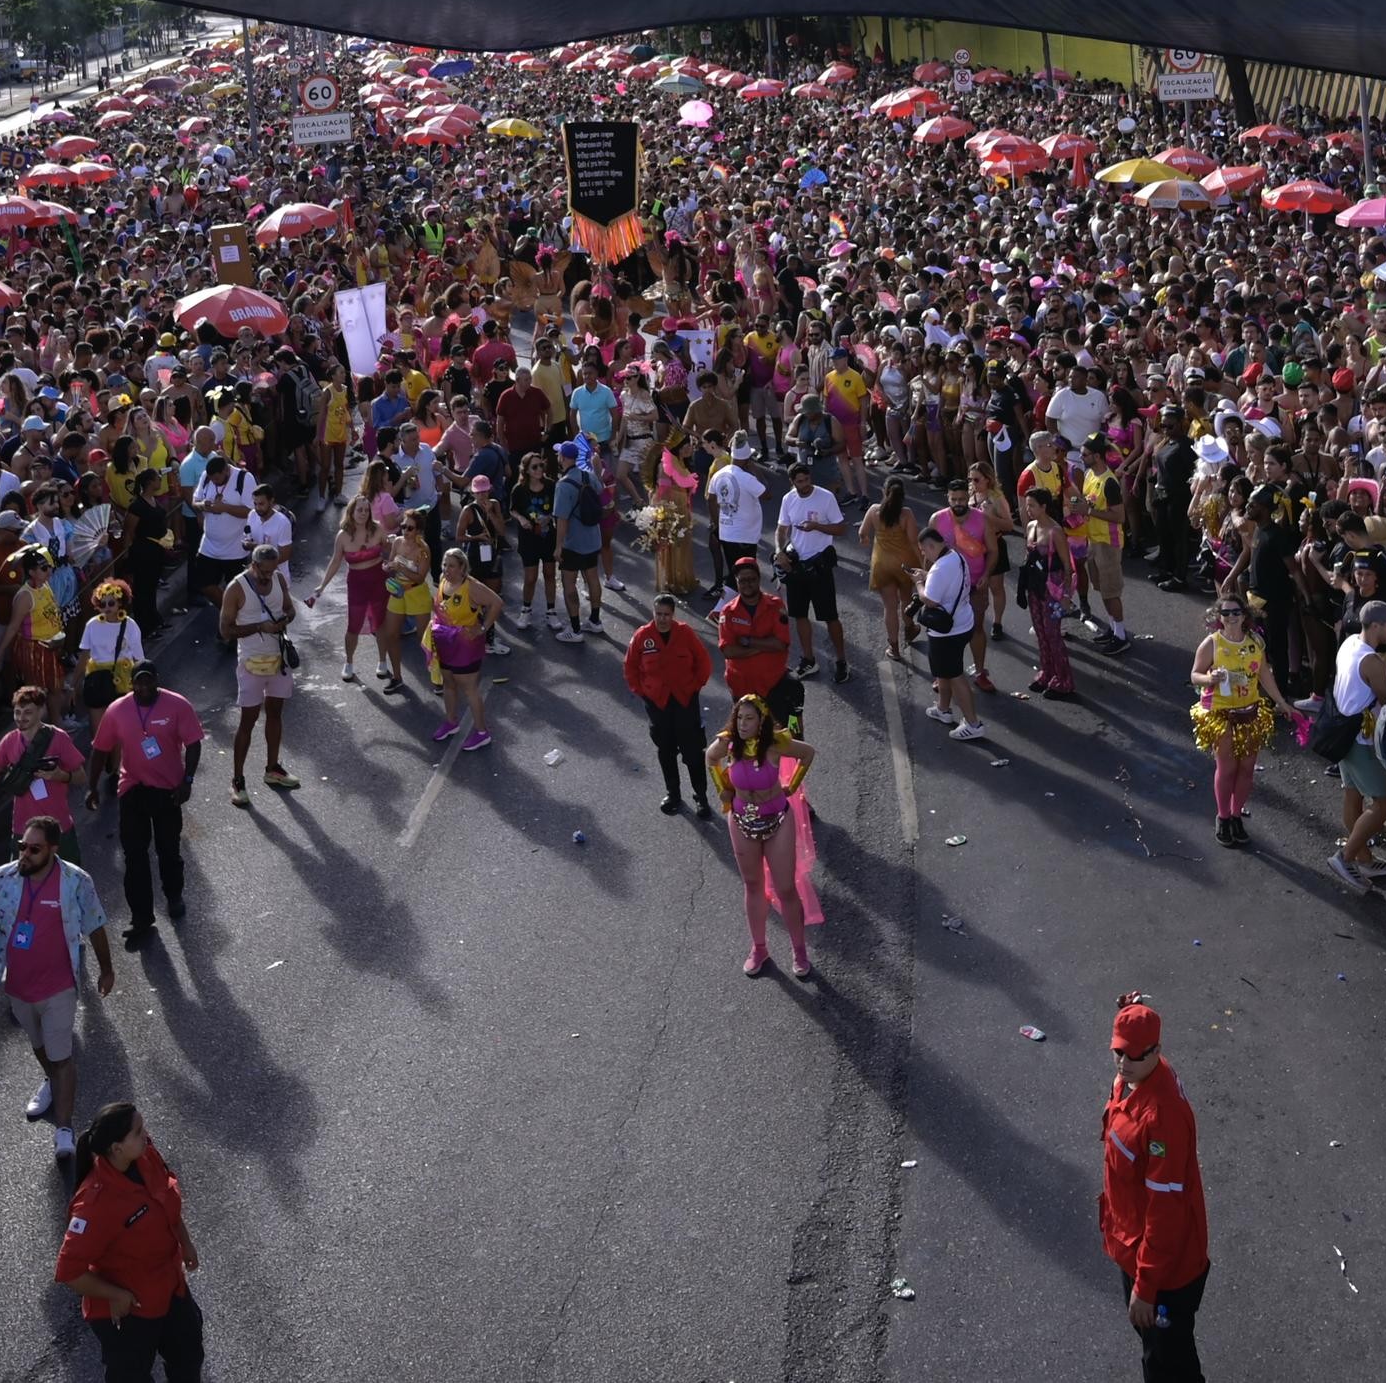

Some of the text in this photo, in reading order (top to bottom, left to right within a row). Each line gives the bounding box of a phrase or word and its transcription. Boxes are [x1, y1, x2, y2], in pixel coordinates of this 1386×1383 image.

[1159, 77, 1212, 86] FISCALIZAÇÃO
[308, 86, 332, 101] 60
[1163, 87, 1209, 96] ELETRÔNICA
[294, 118, 349, 129] FISCALIZAÇÃO
[299, 129, 346, 139] ELETRÔNICA
[229, 306, 275, 322] BRAHMA
